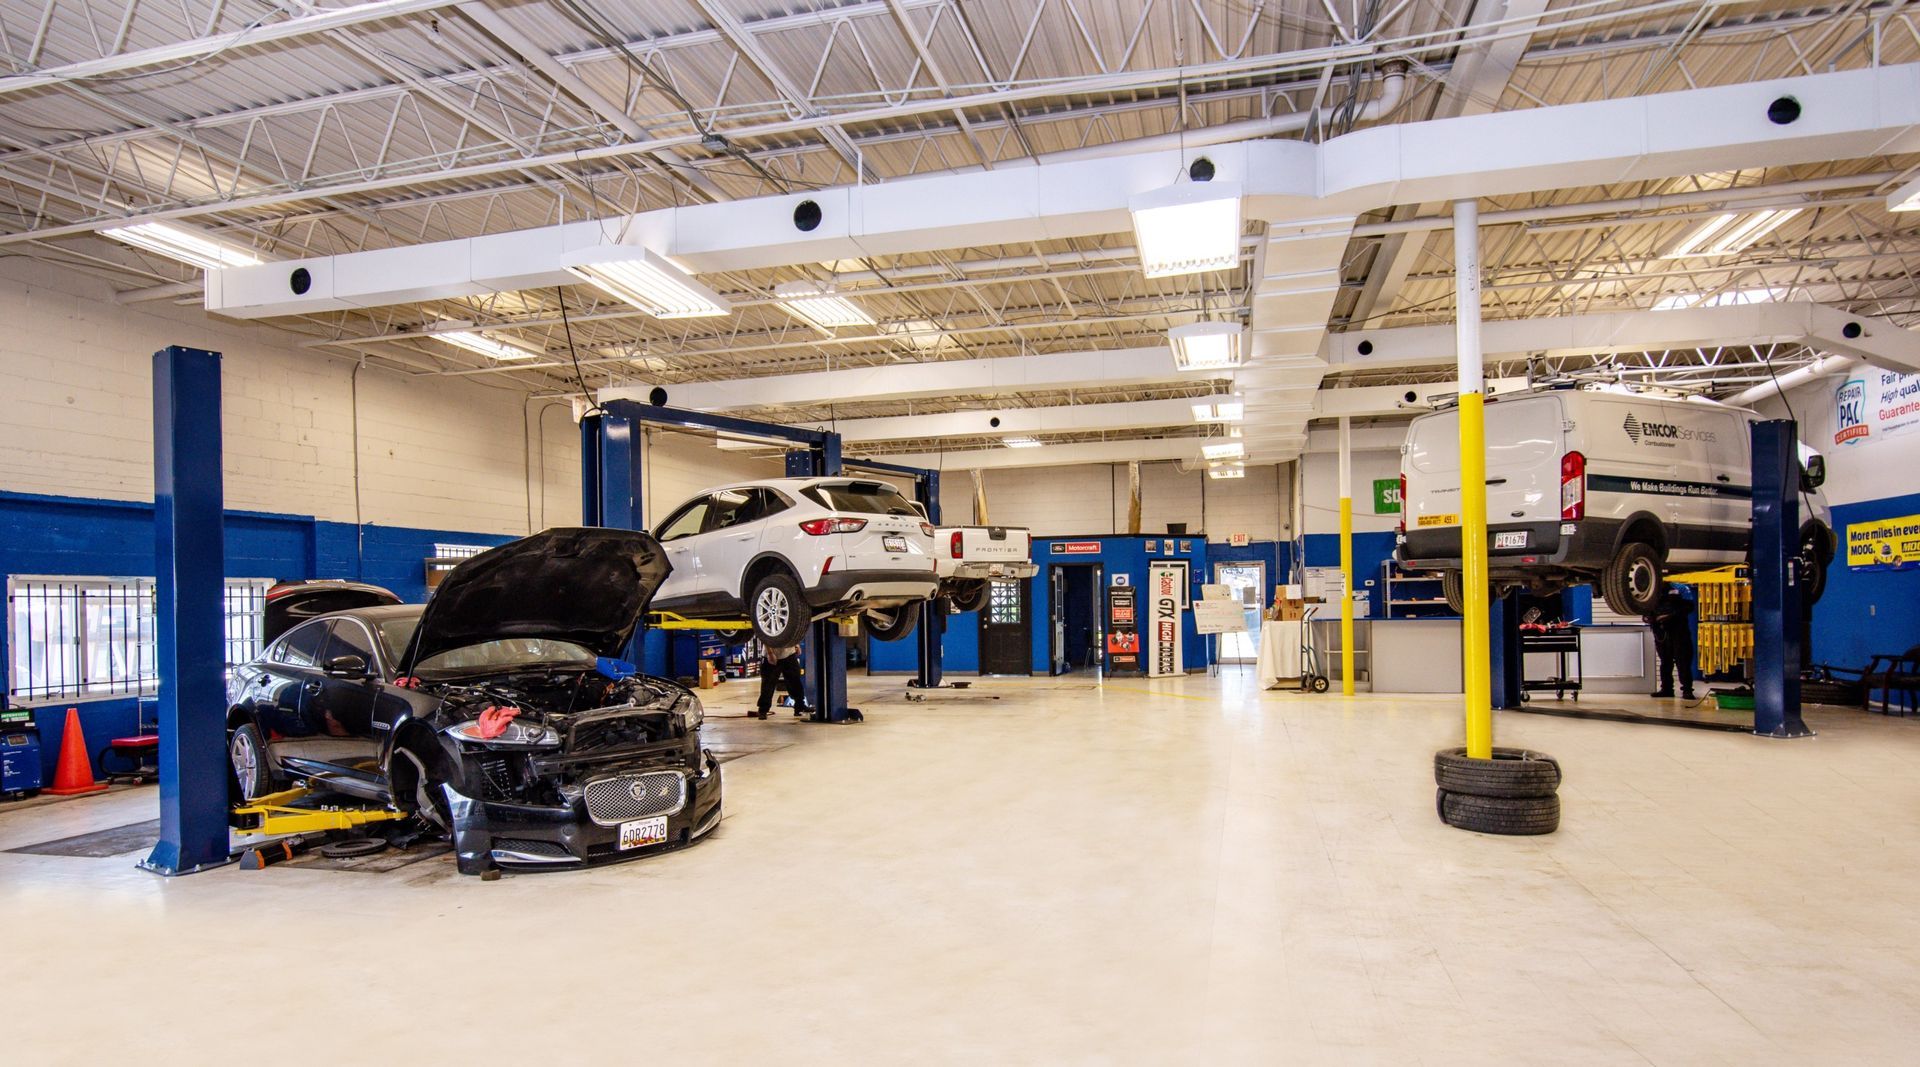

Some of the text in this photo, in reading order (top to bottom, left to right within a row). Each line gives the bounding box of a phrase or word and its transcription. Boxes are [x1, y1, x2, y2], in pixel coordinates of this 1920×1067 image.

[1881, 371, 1896, 386] Fair
[1839, 386, 1861, 402] REPAIR
[1880, 387, 1898, 404] High
[1840, 400, 1859, 428] PAL
[1641, 422, 1717, 443] EMCOR Services
[1630, 481, 1641, 491] We
[1641, 482, 1658, 492] Make
[1659, 483, 1687, 496] Buildings
[1687, 485, 1699, 495] Run
[1233, 534, 1245, 543] EXIT
[1850, 531, 1870, 542] More
[1870, 527, 1893, 540] miles
[1893, 525, 1902, 537] in
[1160, 576, 1173, 596] Castrol
[1158, 598, 1175, 620] GTX
[1161, 622, 1172, 641] HIGH
[623, 823, 665, 843] 6DR2778
